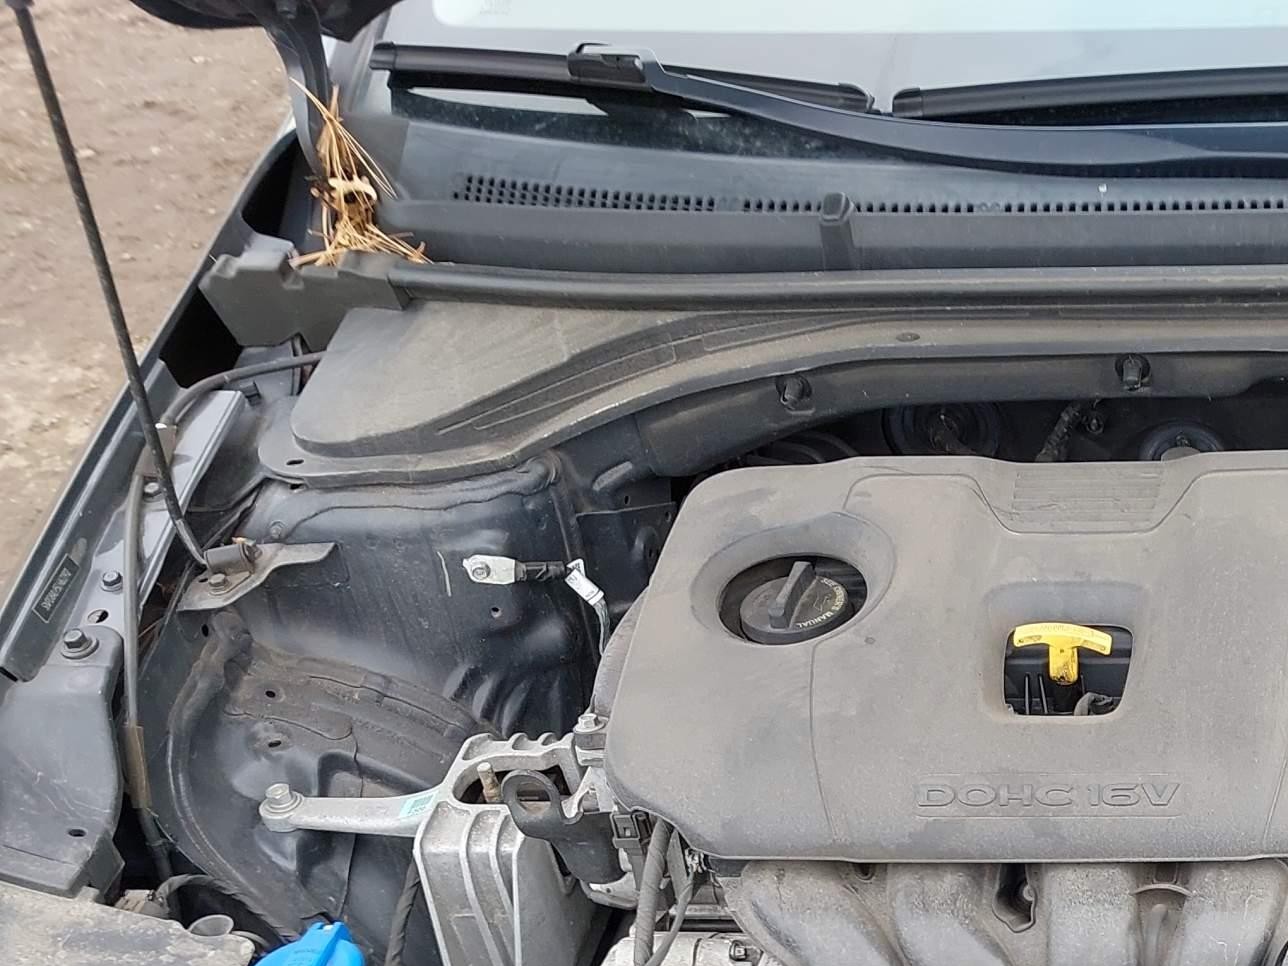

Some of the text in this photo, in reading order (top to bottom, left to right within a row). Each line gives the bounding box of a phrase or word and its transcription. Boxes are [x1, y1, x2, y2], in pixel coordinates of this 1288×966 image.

[798, 610, 834, 628] MANUAL
[916, 783, 1181, 807] DOHC 16V
